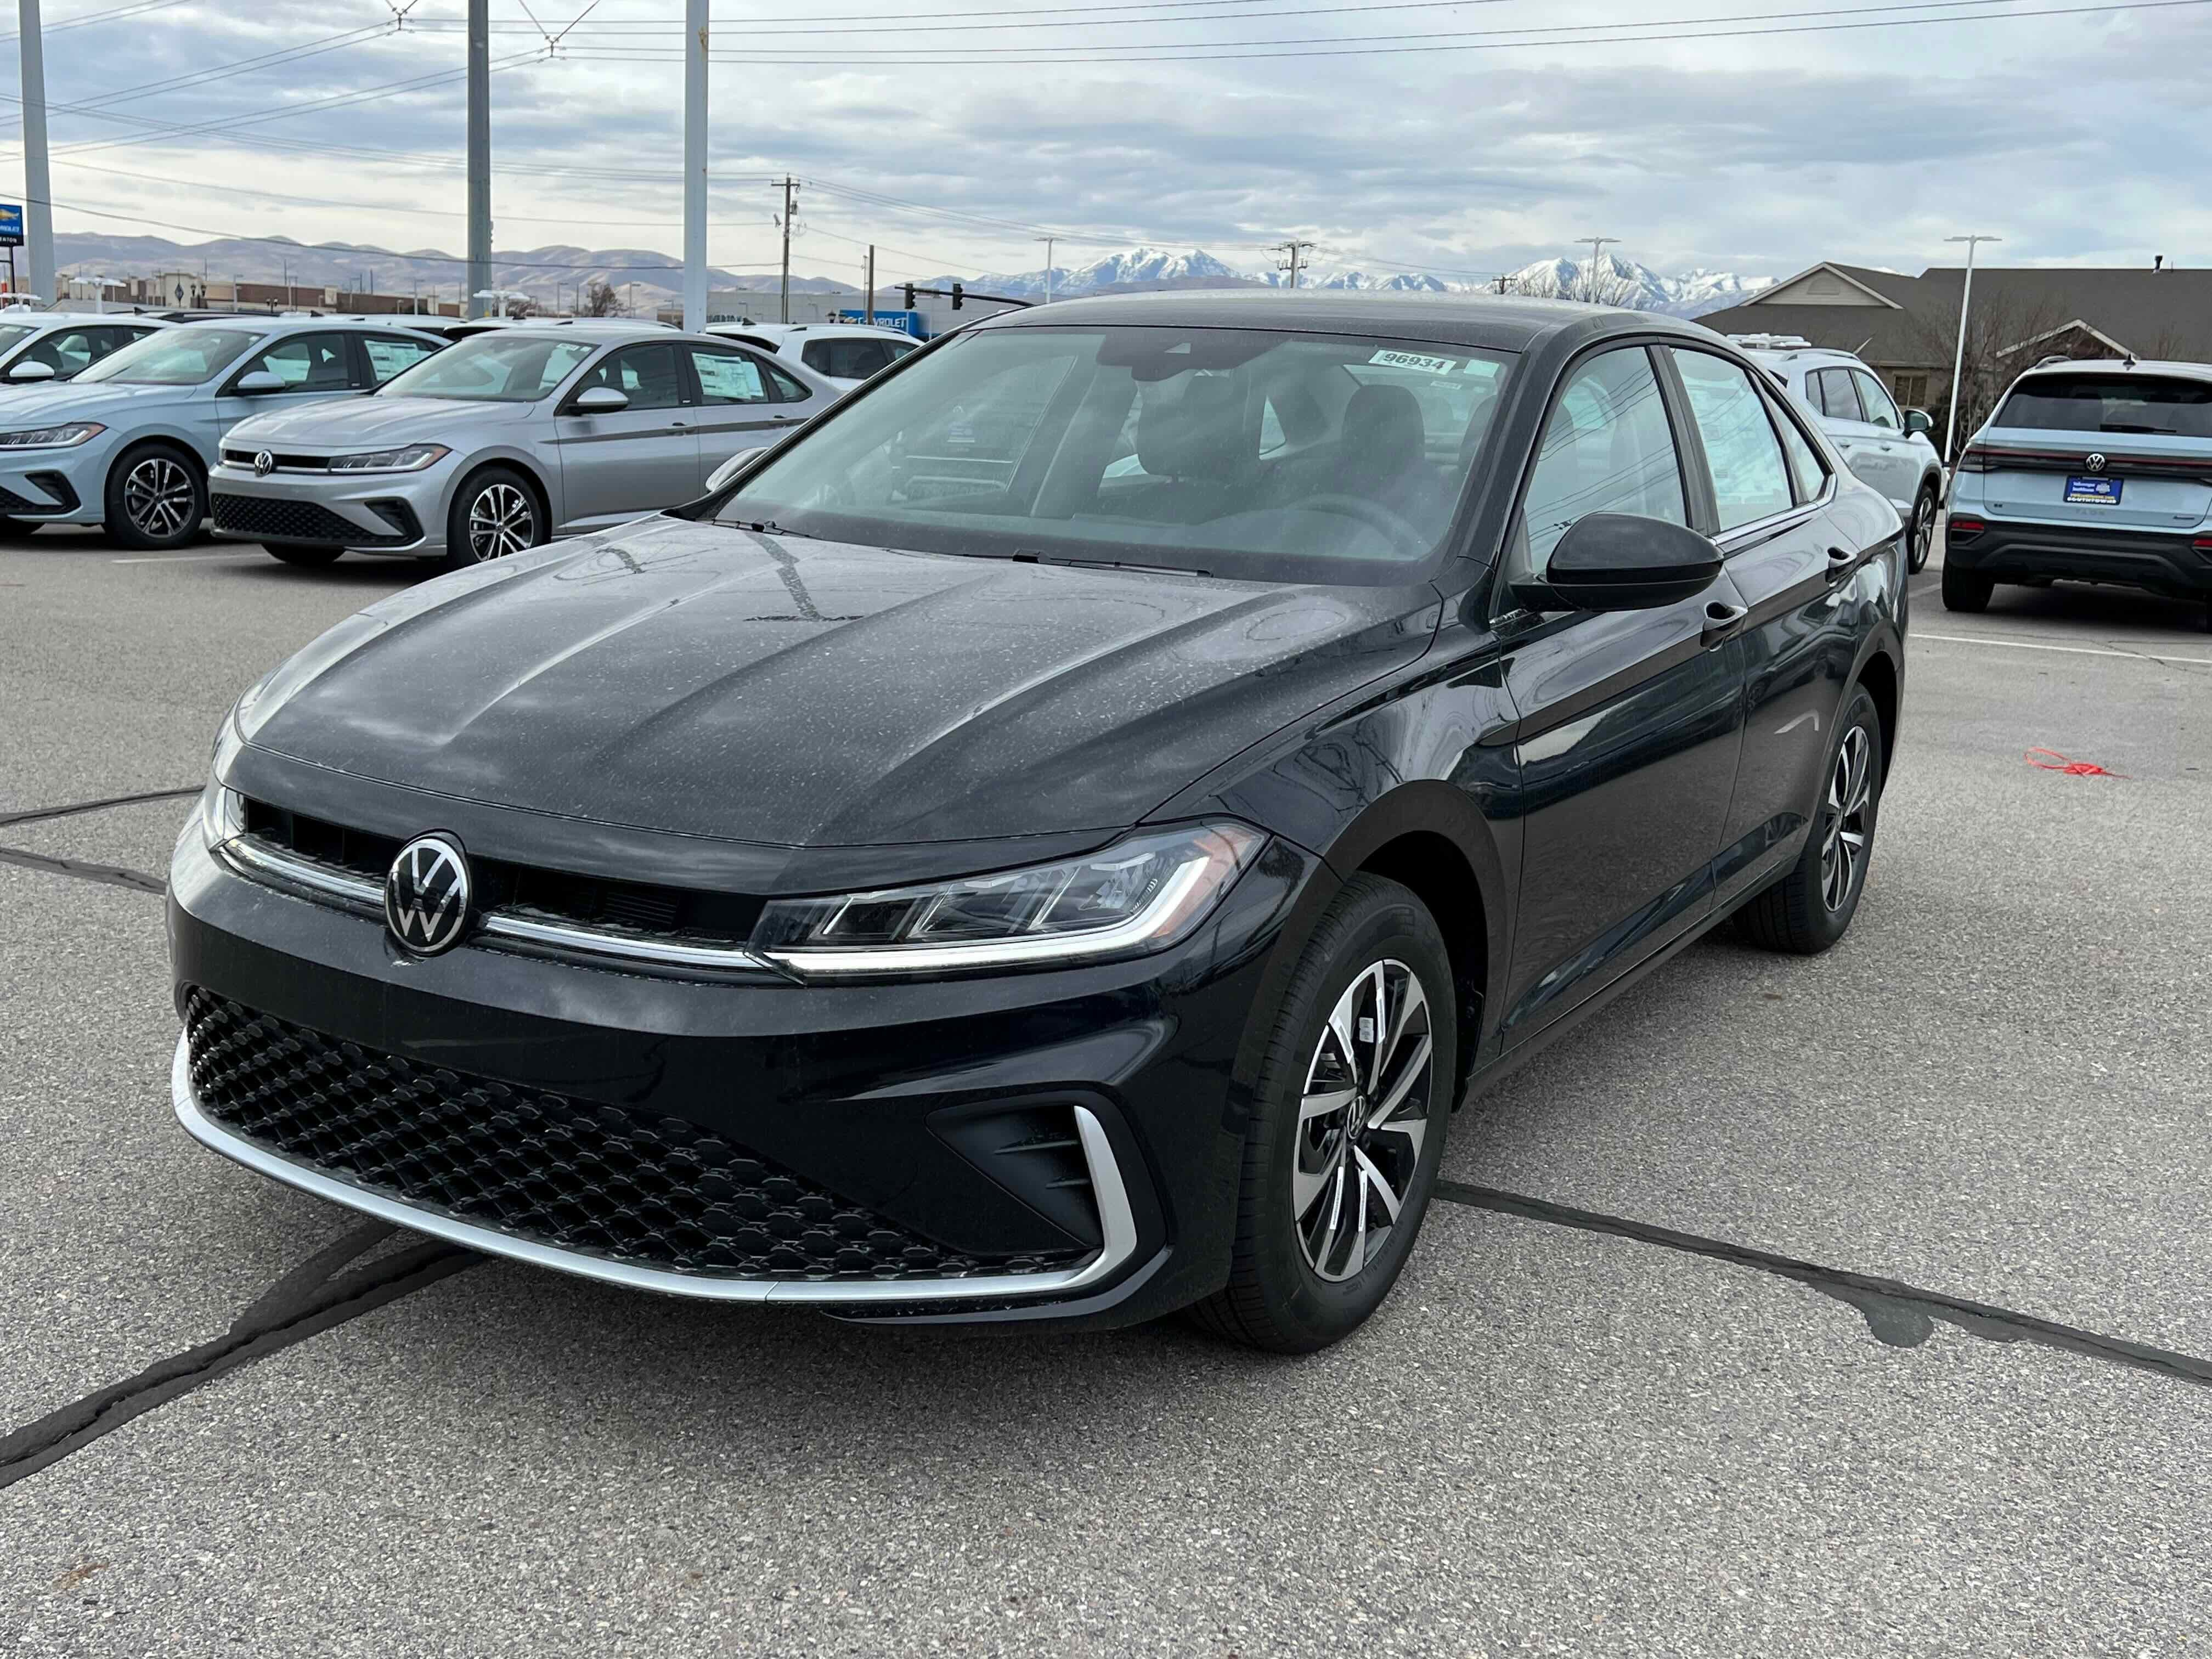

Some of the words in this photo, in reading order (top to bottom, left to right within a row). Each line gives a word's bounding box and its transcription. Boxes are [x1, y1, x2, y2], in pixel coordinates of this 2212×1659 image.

[1383, 353, 1446, 369] 96934
[2086, 453, 2105, 471] VW
[386, 838, 468, 952] VW
